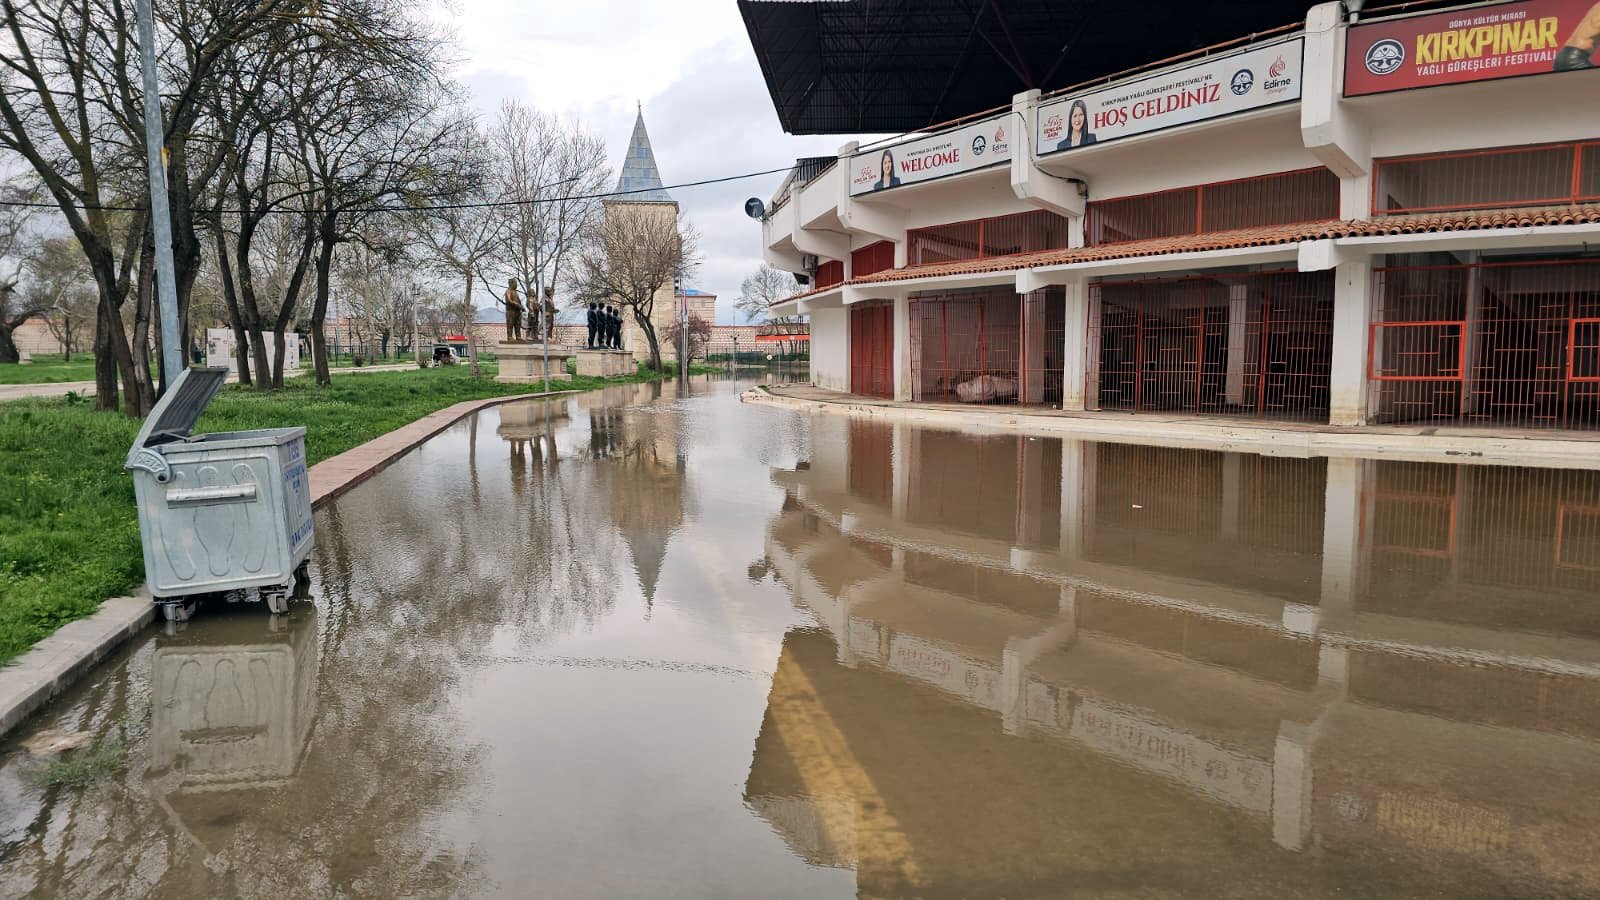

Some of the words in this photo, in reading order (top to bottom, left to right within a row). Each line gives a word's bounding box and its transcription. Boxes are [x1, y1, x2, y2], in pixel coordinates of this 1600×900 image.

[1449, 19, 1472, 29] DÜNYA
[1473, 15, 1499, 25] KÜLTÜR
[1415, 17, 1558, 64] KIRKPINAR
[1416, 63, 1445, 76] YAĞLI
[1263, 77, 1292, 90] Edirne
[1094, 106, 1128, 129] HOŞ
[1132, 82, 1221, 121] GELDİNİZ
[900, 148, 960, 174] WELCOME
